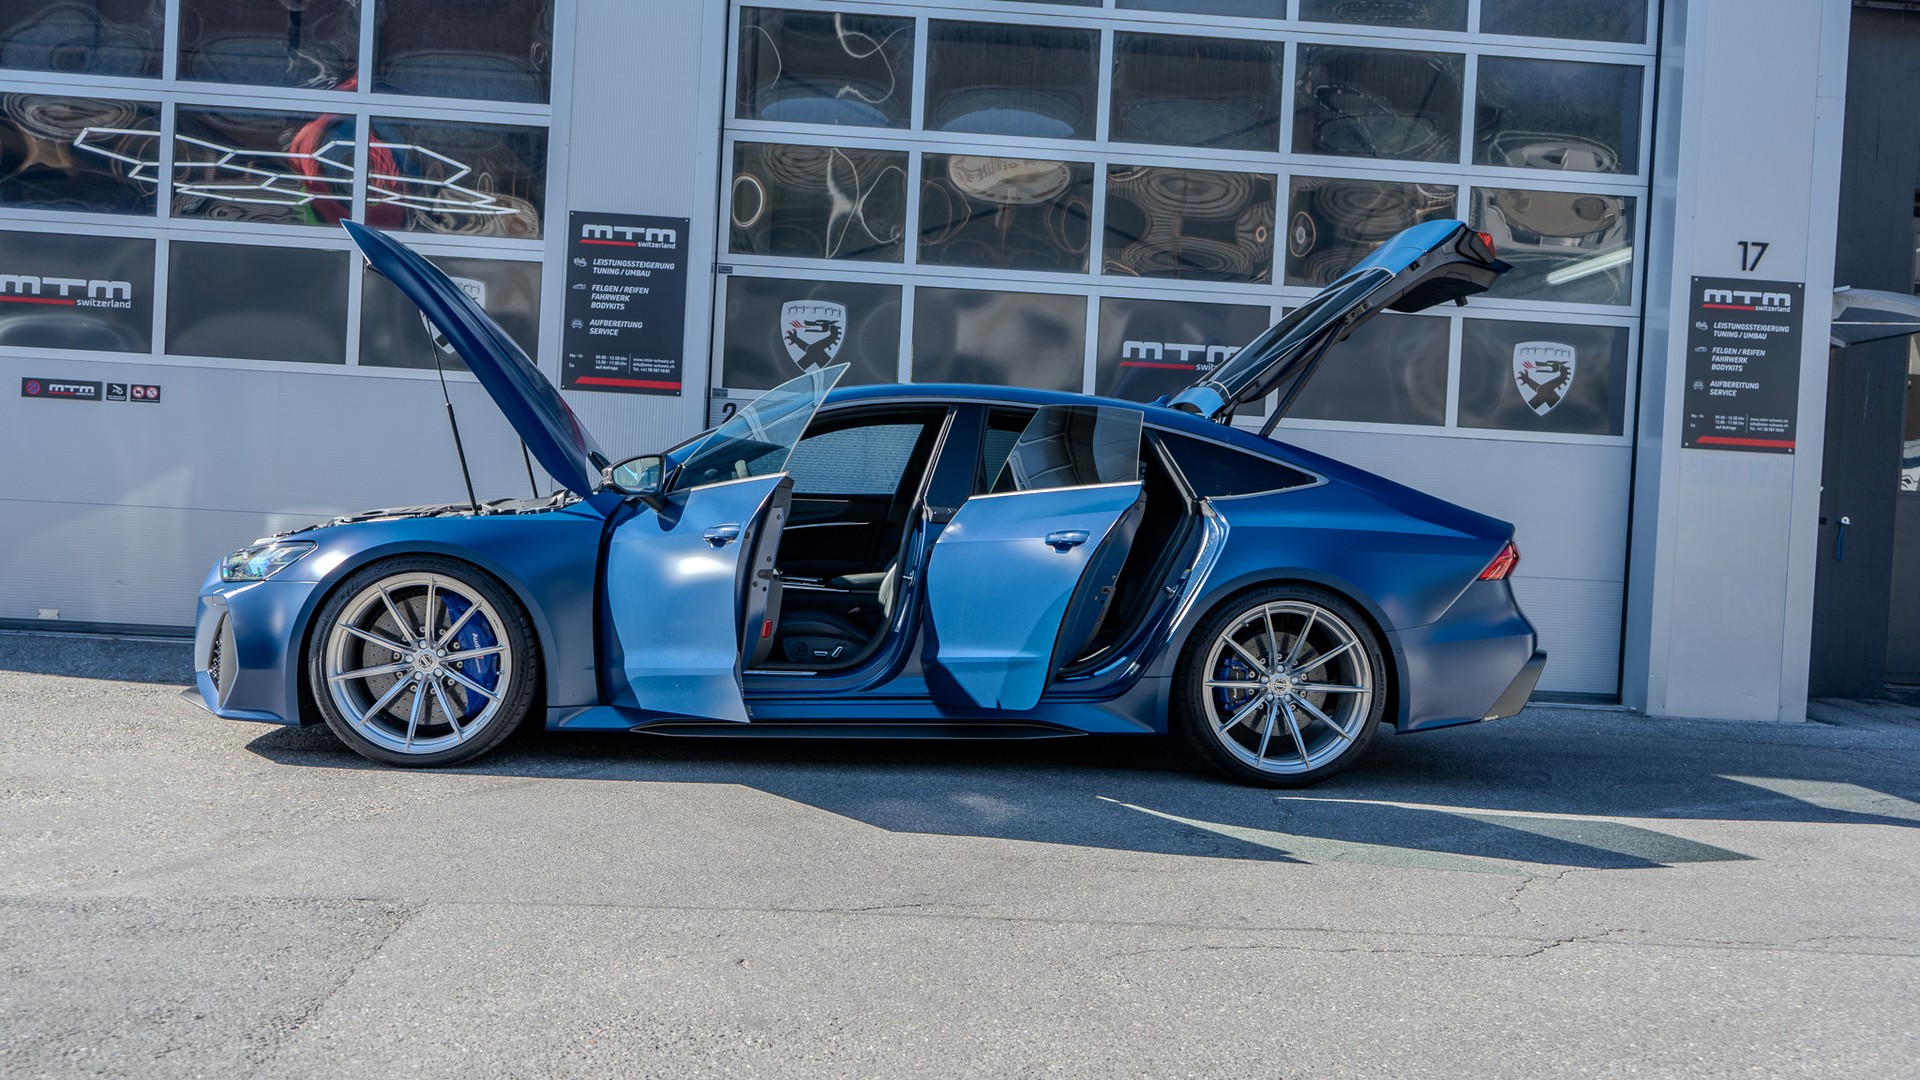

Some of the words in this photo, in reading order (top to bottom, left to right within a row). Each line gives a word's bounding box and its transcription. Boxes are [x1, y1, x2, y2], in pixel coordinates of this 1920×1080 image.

[638, 241, 676, 249] switzerland
[1738, 241, 1769, 271] 17
[593, 258, 675, 270] LEISTUNGSSTEIGERUNG
[593, 267, 620, 275] TUNING
[591, 293, 630, 302] FAHRWERK
[77, 298, 131, 309] switzerland
[591, 302, 625, 310] BODYKITS
[589, 319, 643, 328] AUFBEREITUNG
[1714, 322, 1789, 332] LEISTUNGSSTEIGERUNG
[1712, 355, 1748, 364] FAHRWERK
[1710, 381, 1759, 389] AUFBEREITUNG
[722, 402, 737, 424] 2
